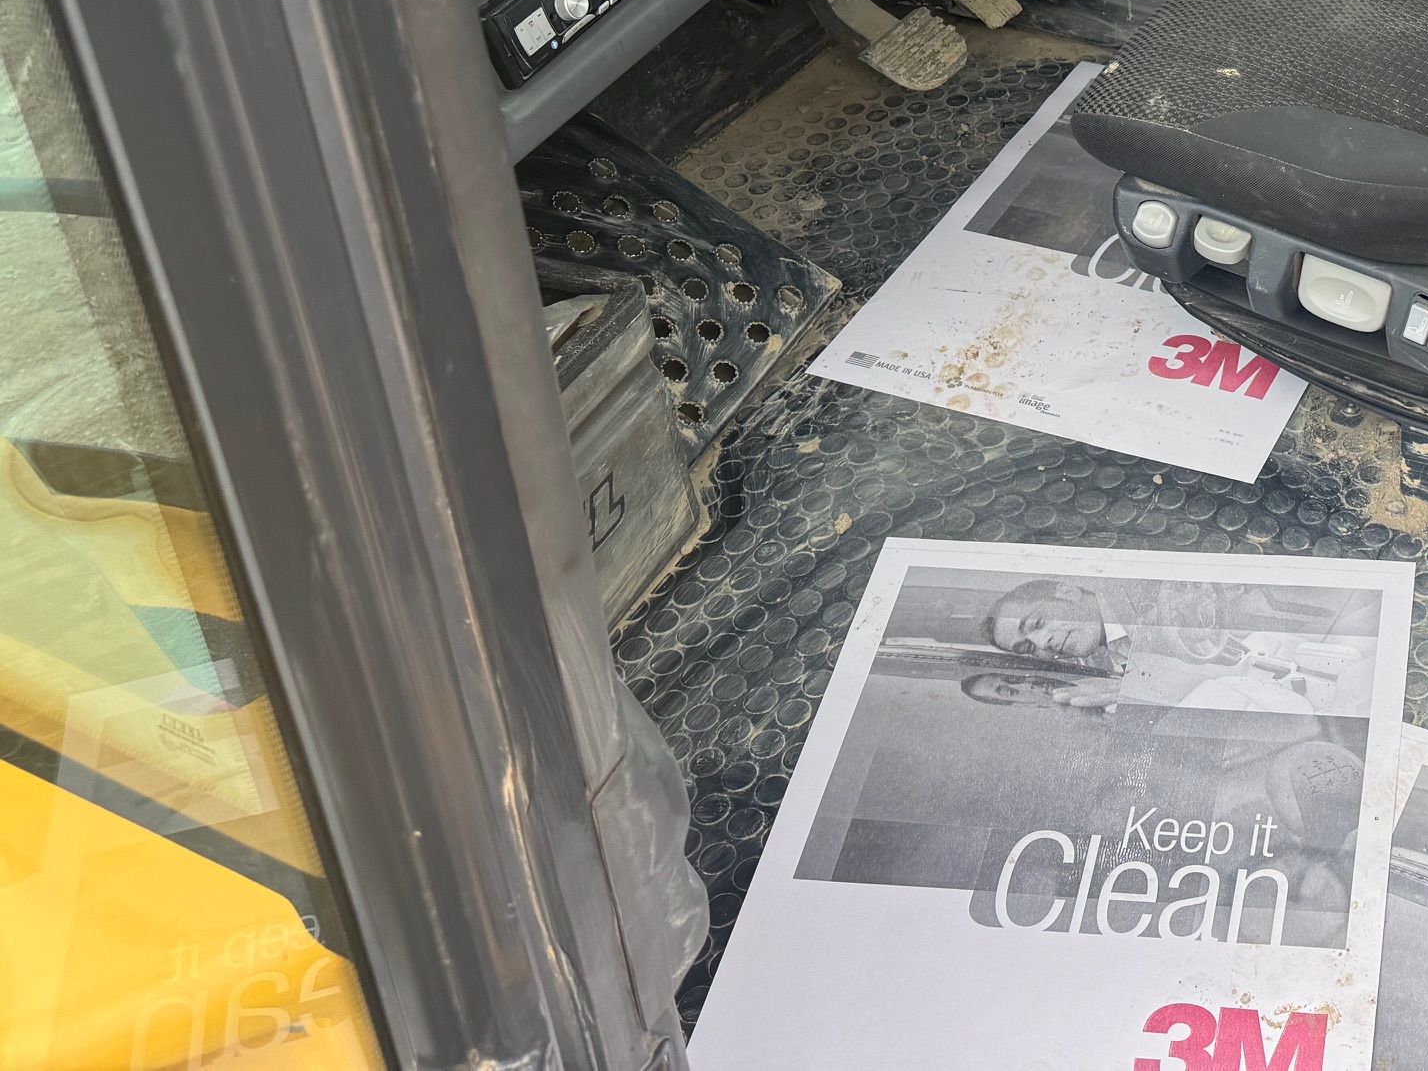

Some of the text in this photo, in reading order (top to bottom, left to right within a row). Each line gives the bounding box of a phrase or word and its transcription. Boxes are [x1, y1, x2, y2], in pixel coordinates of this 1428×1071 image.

[875, 361, 931, 380] MADE IN USA
[1147, 334, 1281, 400] 3M
[1018, 396, 1051, 411] image
[1118, 806, 1278, 863] Keep it
[994, 830, 1289, 946] Clean
[1134, 1003, 1328, 1071] 3M
